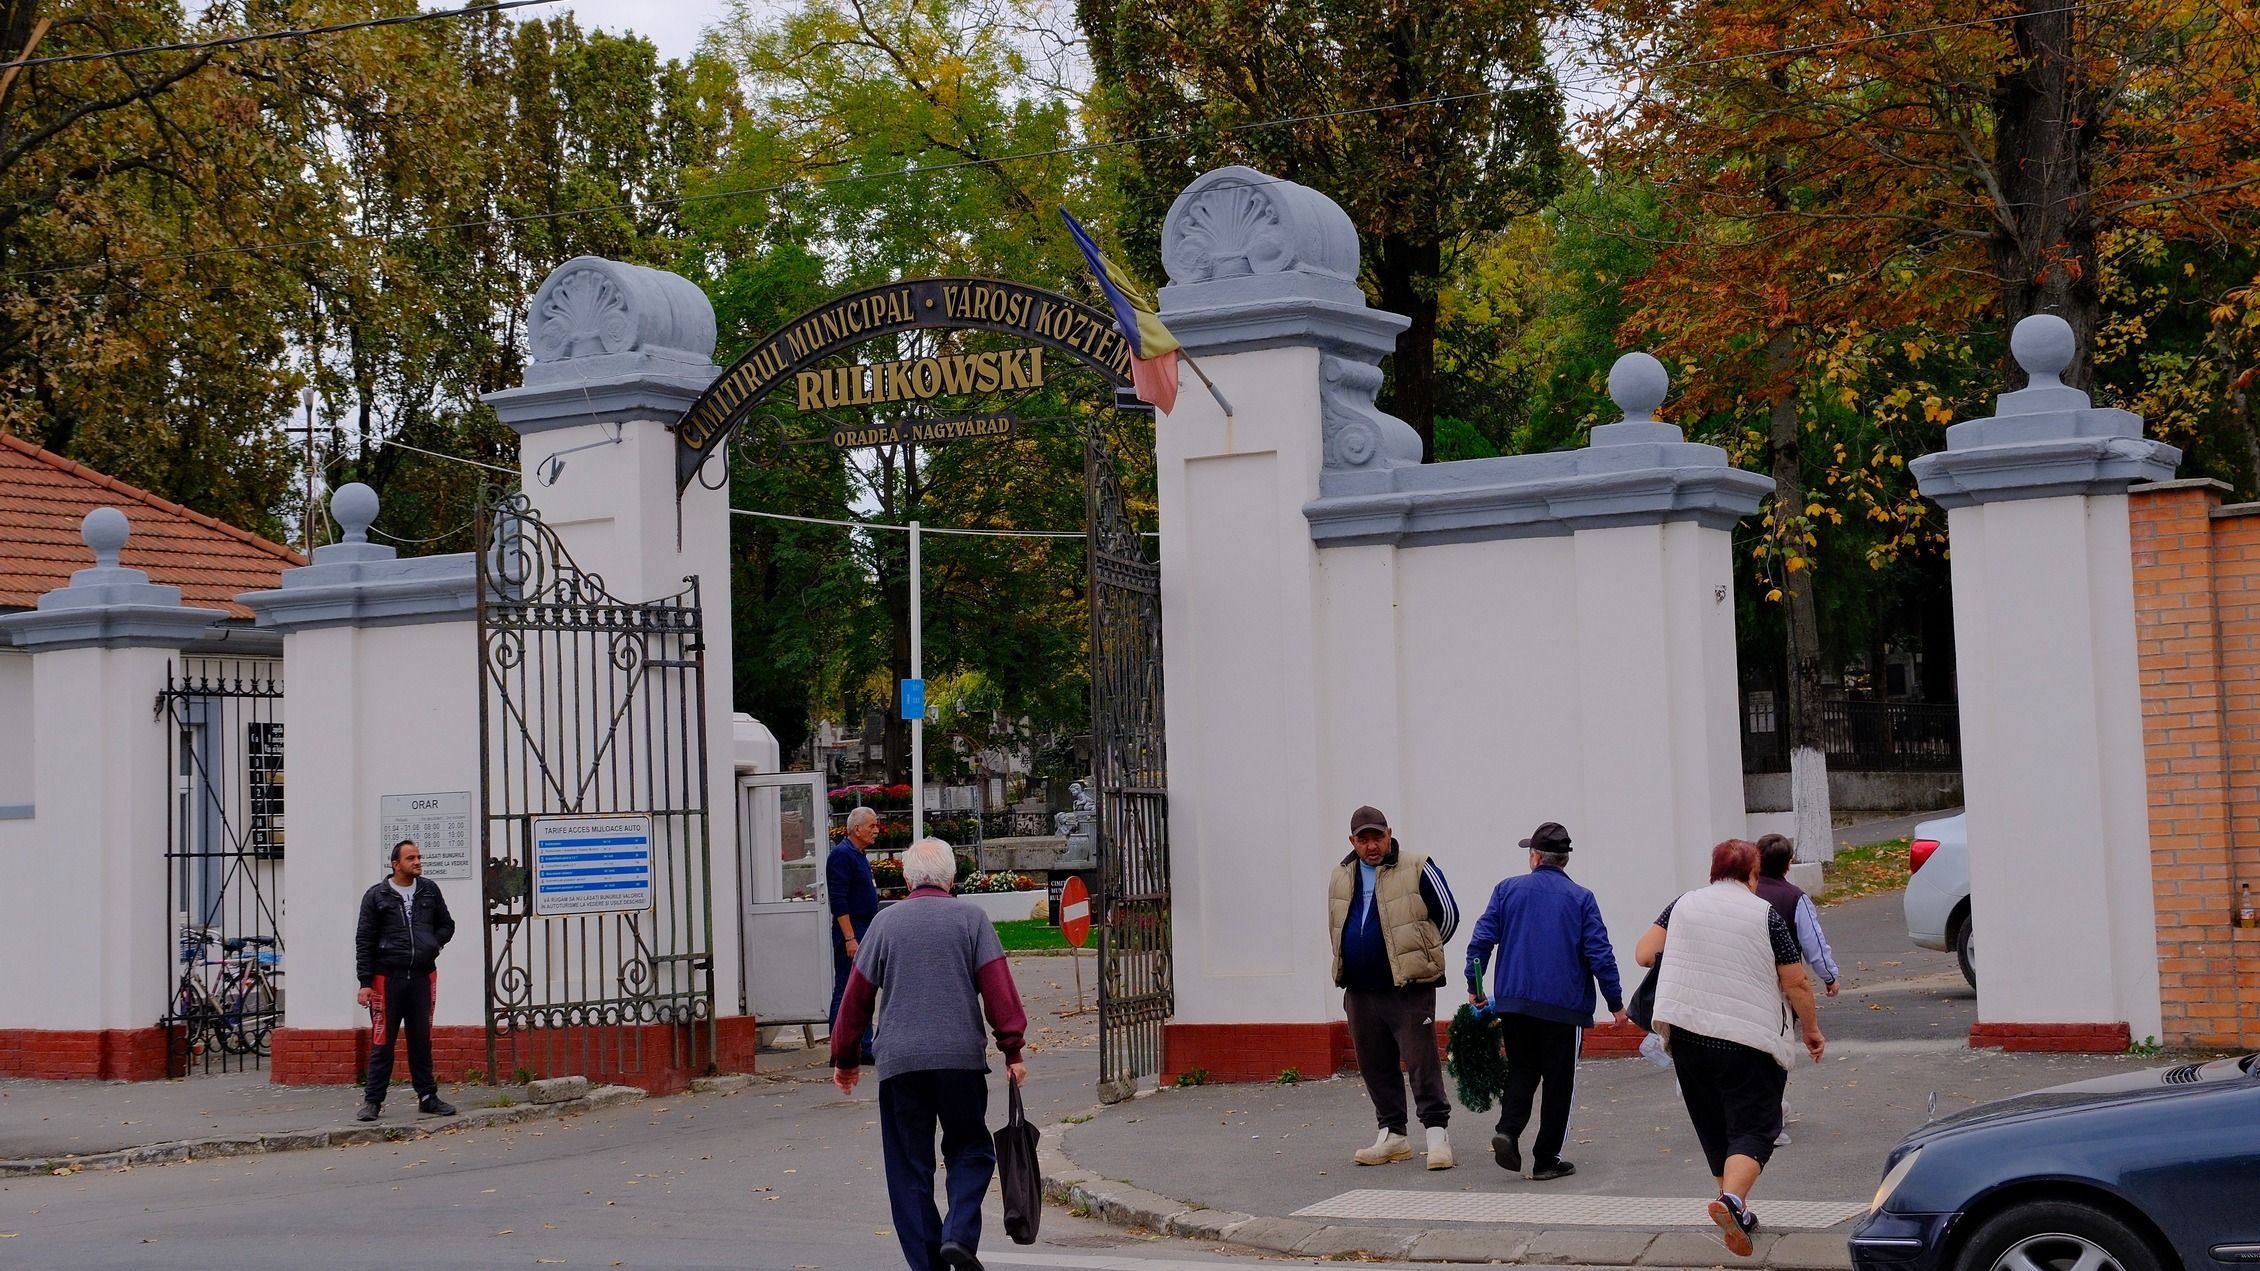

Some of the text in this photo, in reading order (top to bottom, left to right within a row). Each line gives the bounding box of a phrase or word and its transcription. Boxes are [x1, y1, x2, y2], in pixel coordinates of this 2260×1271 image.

[682, 280, 1132, 450] CIMITIRUL MUNICIPAL VÁROSI KÖZTEM
[796, 345, 1045, 412] RULIKOWSKI
[833, 425, 899, 448] ORADEA
[911, 415, 1010, 441] NAGYVÁRAD
[412, 800, 438, 810] ORAR
[545, 824, 641, 834] TARIFE ACCES MIJLOACE AUTO
